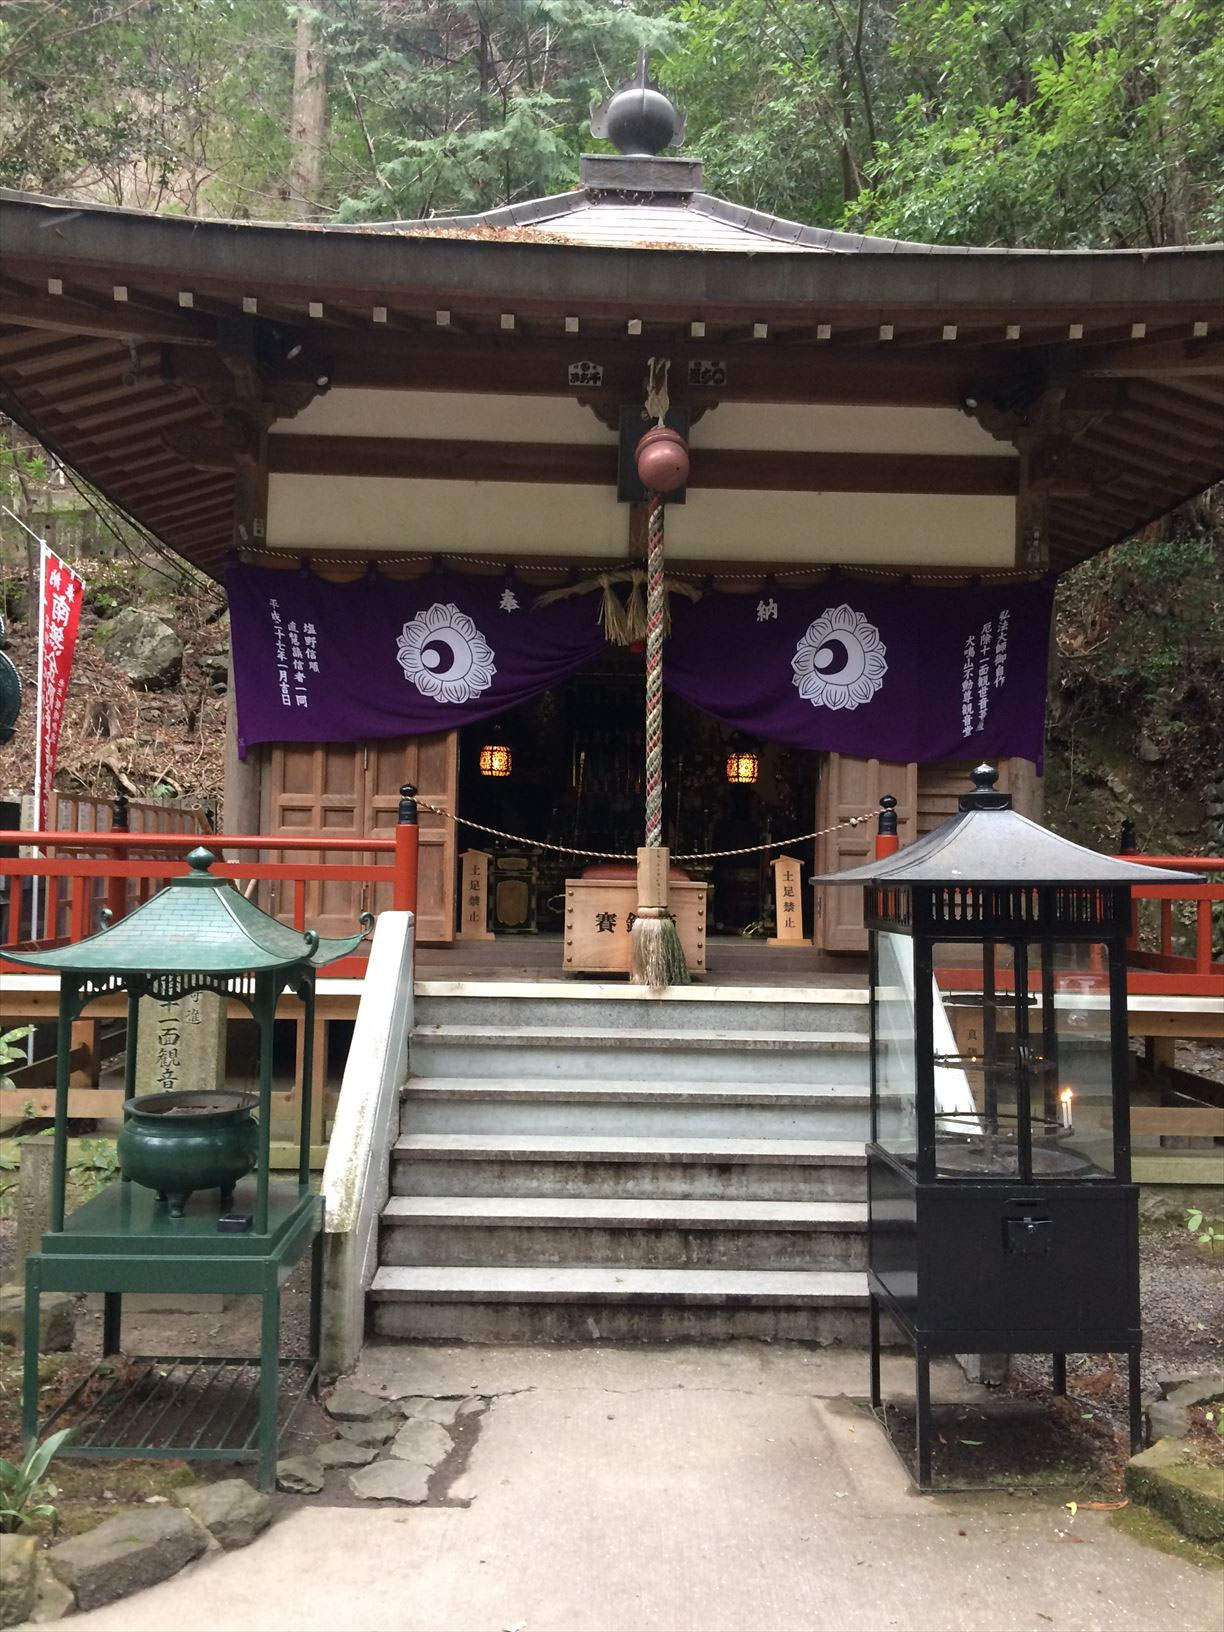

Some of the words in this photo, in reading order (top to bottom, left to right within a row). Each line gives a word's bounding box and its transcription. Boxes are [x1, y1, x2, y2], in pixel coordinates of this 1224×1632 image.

[499, 589, 520, 613] 奉
[756, 598, 778, 622] 納
[269, 598, 292, 707] 平成二十七年一月吉日
[468, 864, 481, 923] 土足禁止
[782, 870, 796, 929] 土足禁止
